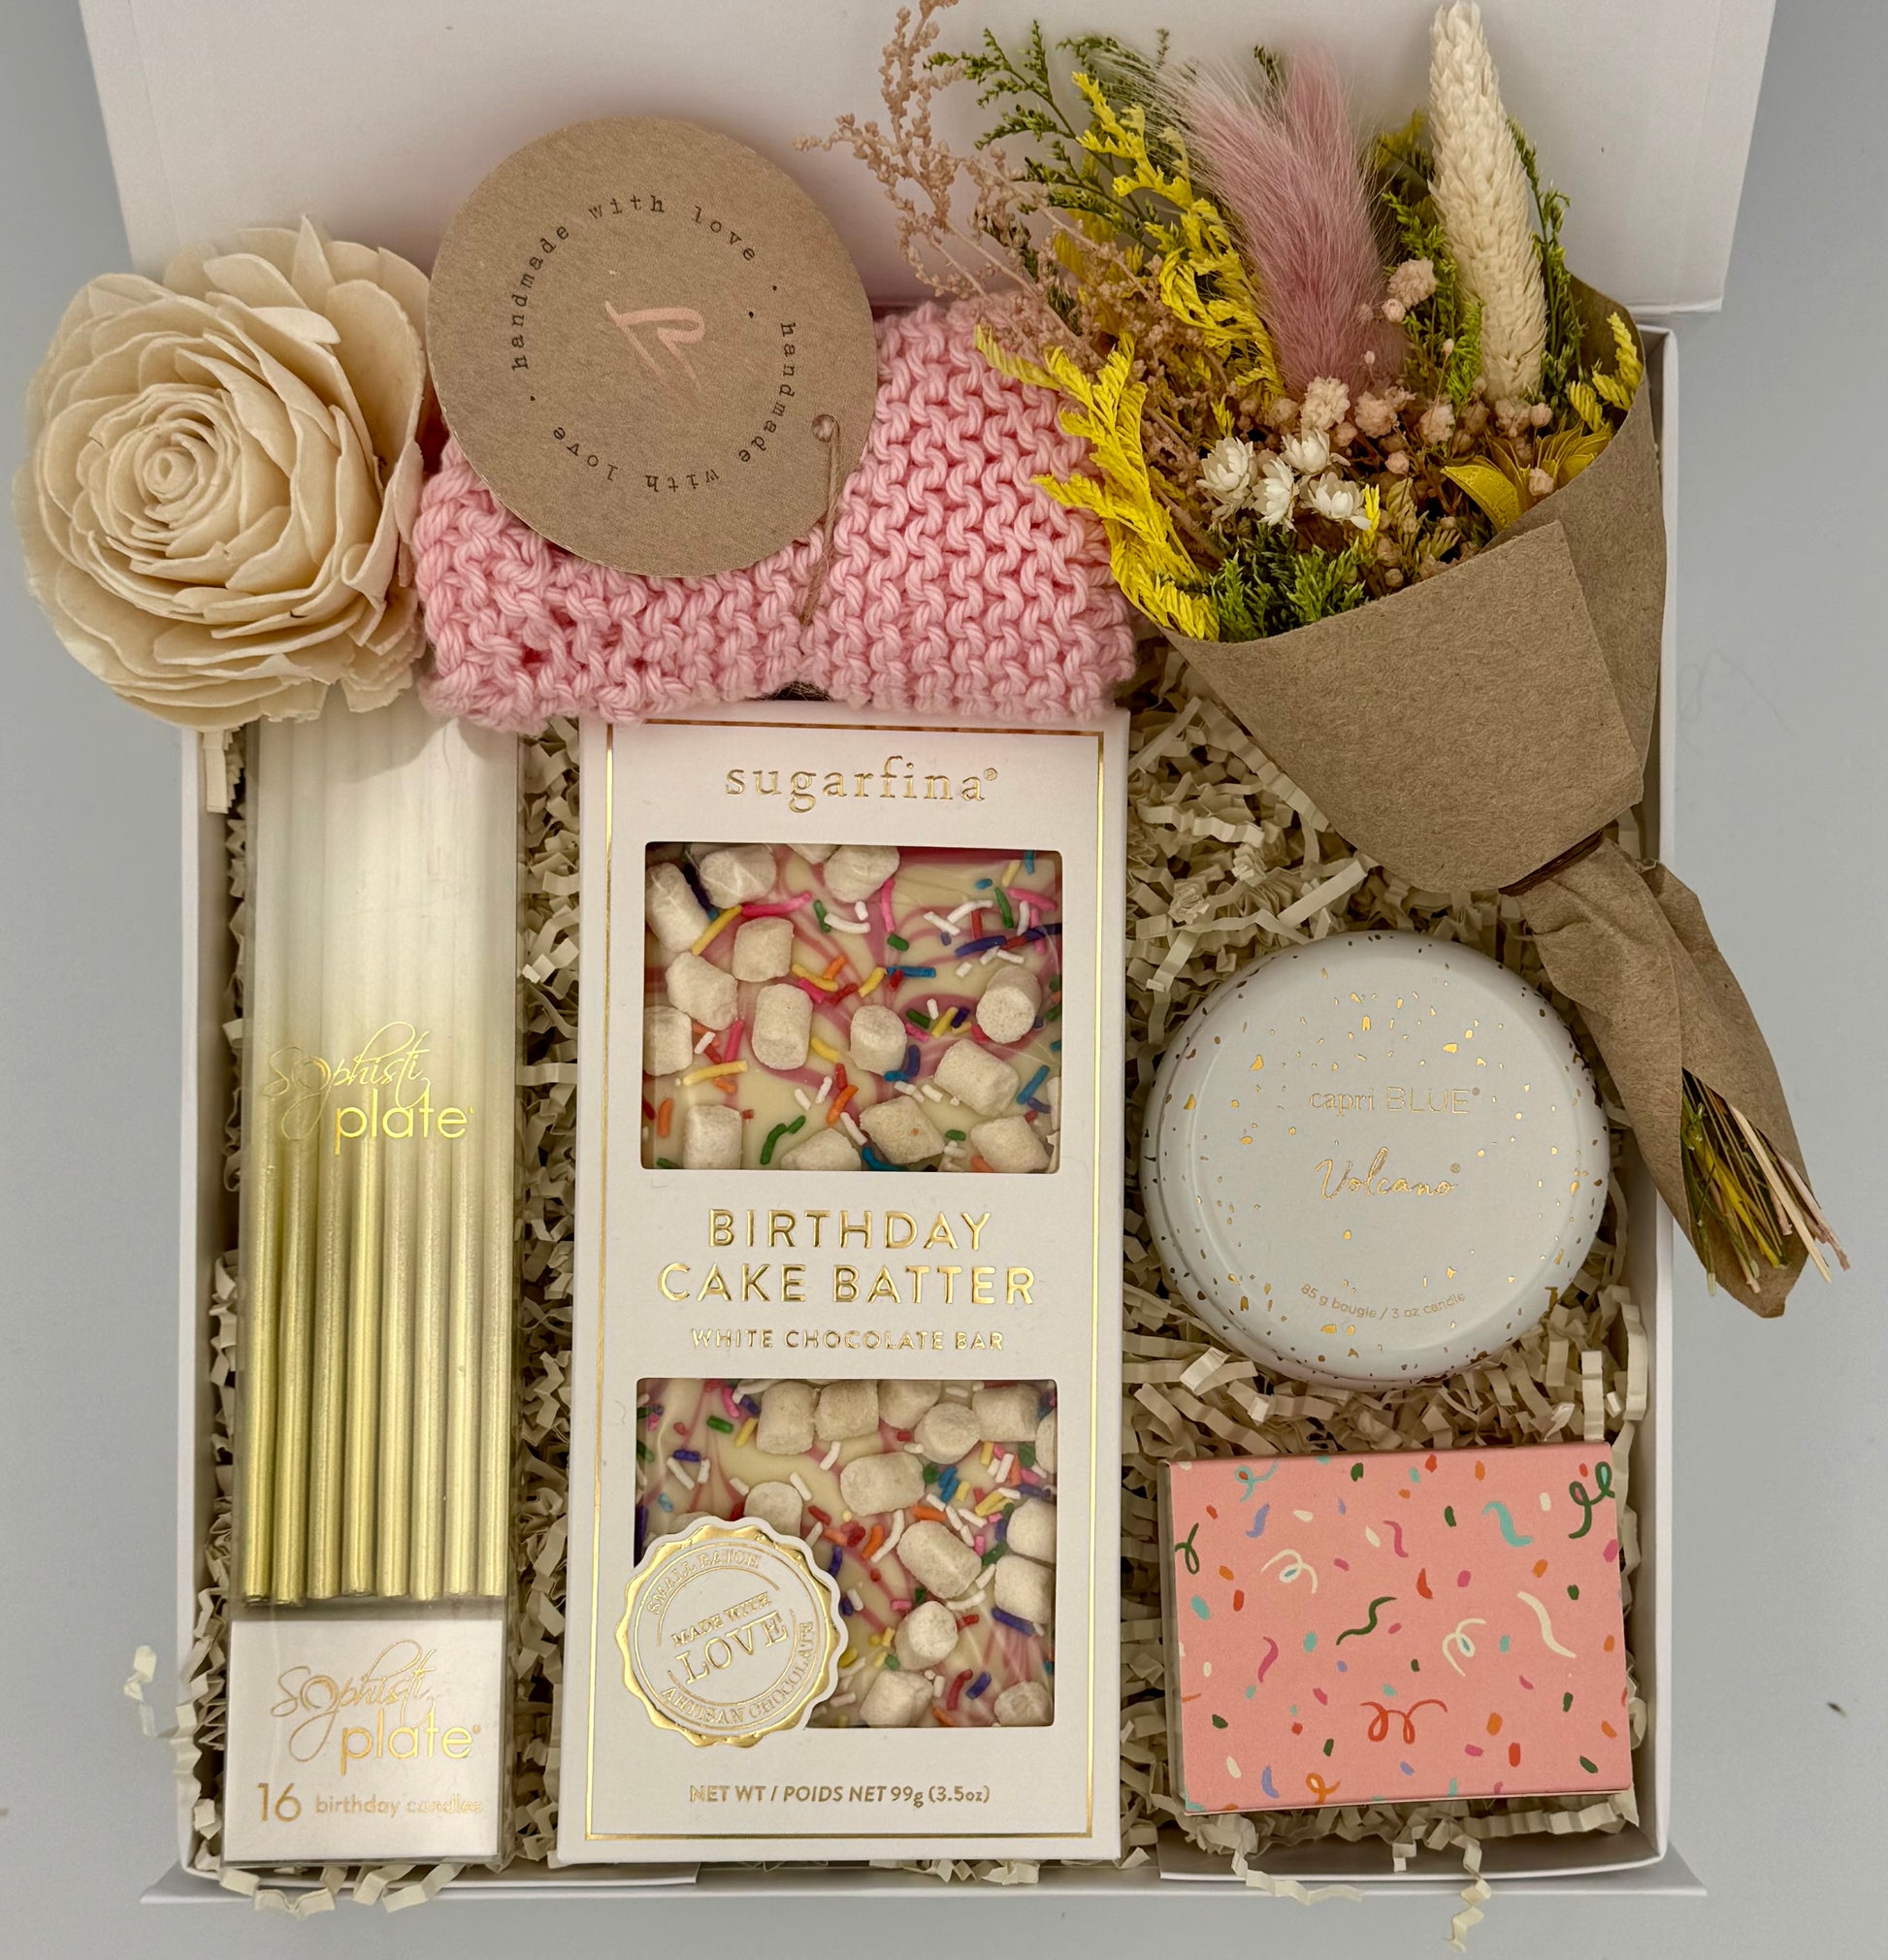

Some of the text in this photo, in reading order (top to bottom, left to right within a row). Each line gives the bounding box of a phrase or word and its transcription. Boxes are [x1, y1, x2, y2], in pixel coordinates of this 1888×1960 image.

[511, 194, 756, 372] handmade with love
[552, 320, 797, 492] handmade with love
[1310, 1088, 1375, 1118] capri
[708, 1208, 991, 1251] BIRTHDAY
[658, 1262, 1035, 1305] CAKE BATTER
[1300, 1283, 1318, 1299] 85
[1319, 1295, 1329, 1307] g
[1331, 1297, 1377, 1319] bougie
[1391, 1307, 1400, 1320] 3
[1404, 1308, 1420, 1319] oz
[1422, 1291, 1467, 1314] candle
[691, 1328, 1004, 1351] WHITE CHOCOLATE BAR
[646, 1550, 762, 1615] SMALL BATCH
[670, 1591, 772, 1648] MADE WITH
[675, 1612, 789, 1684] LOVE
[661, 1621, 815, 1724] ARTISAN CHOCOLATE
[257, 1782, 483, 1822] 16 birthday candles
[690, 1785, 991, 1809] NET WT / POIDS NET 99g (3.5oz)
